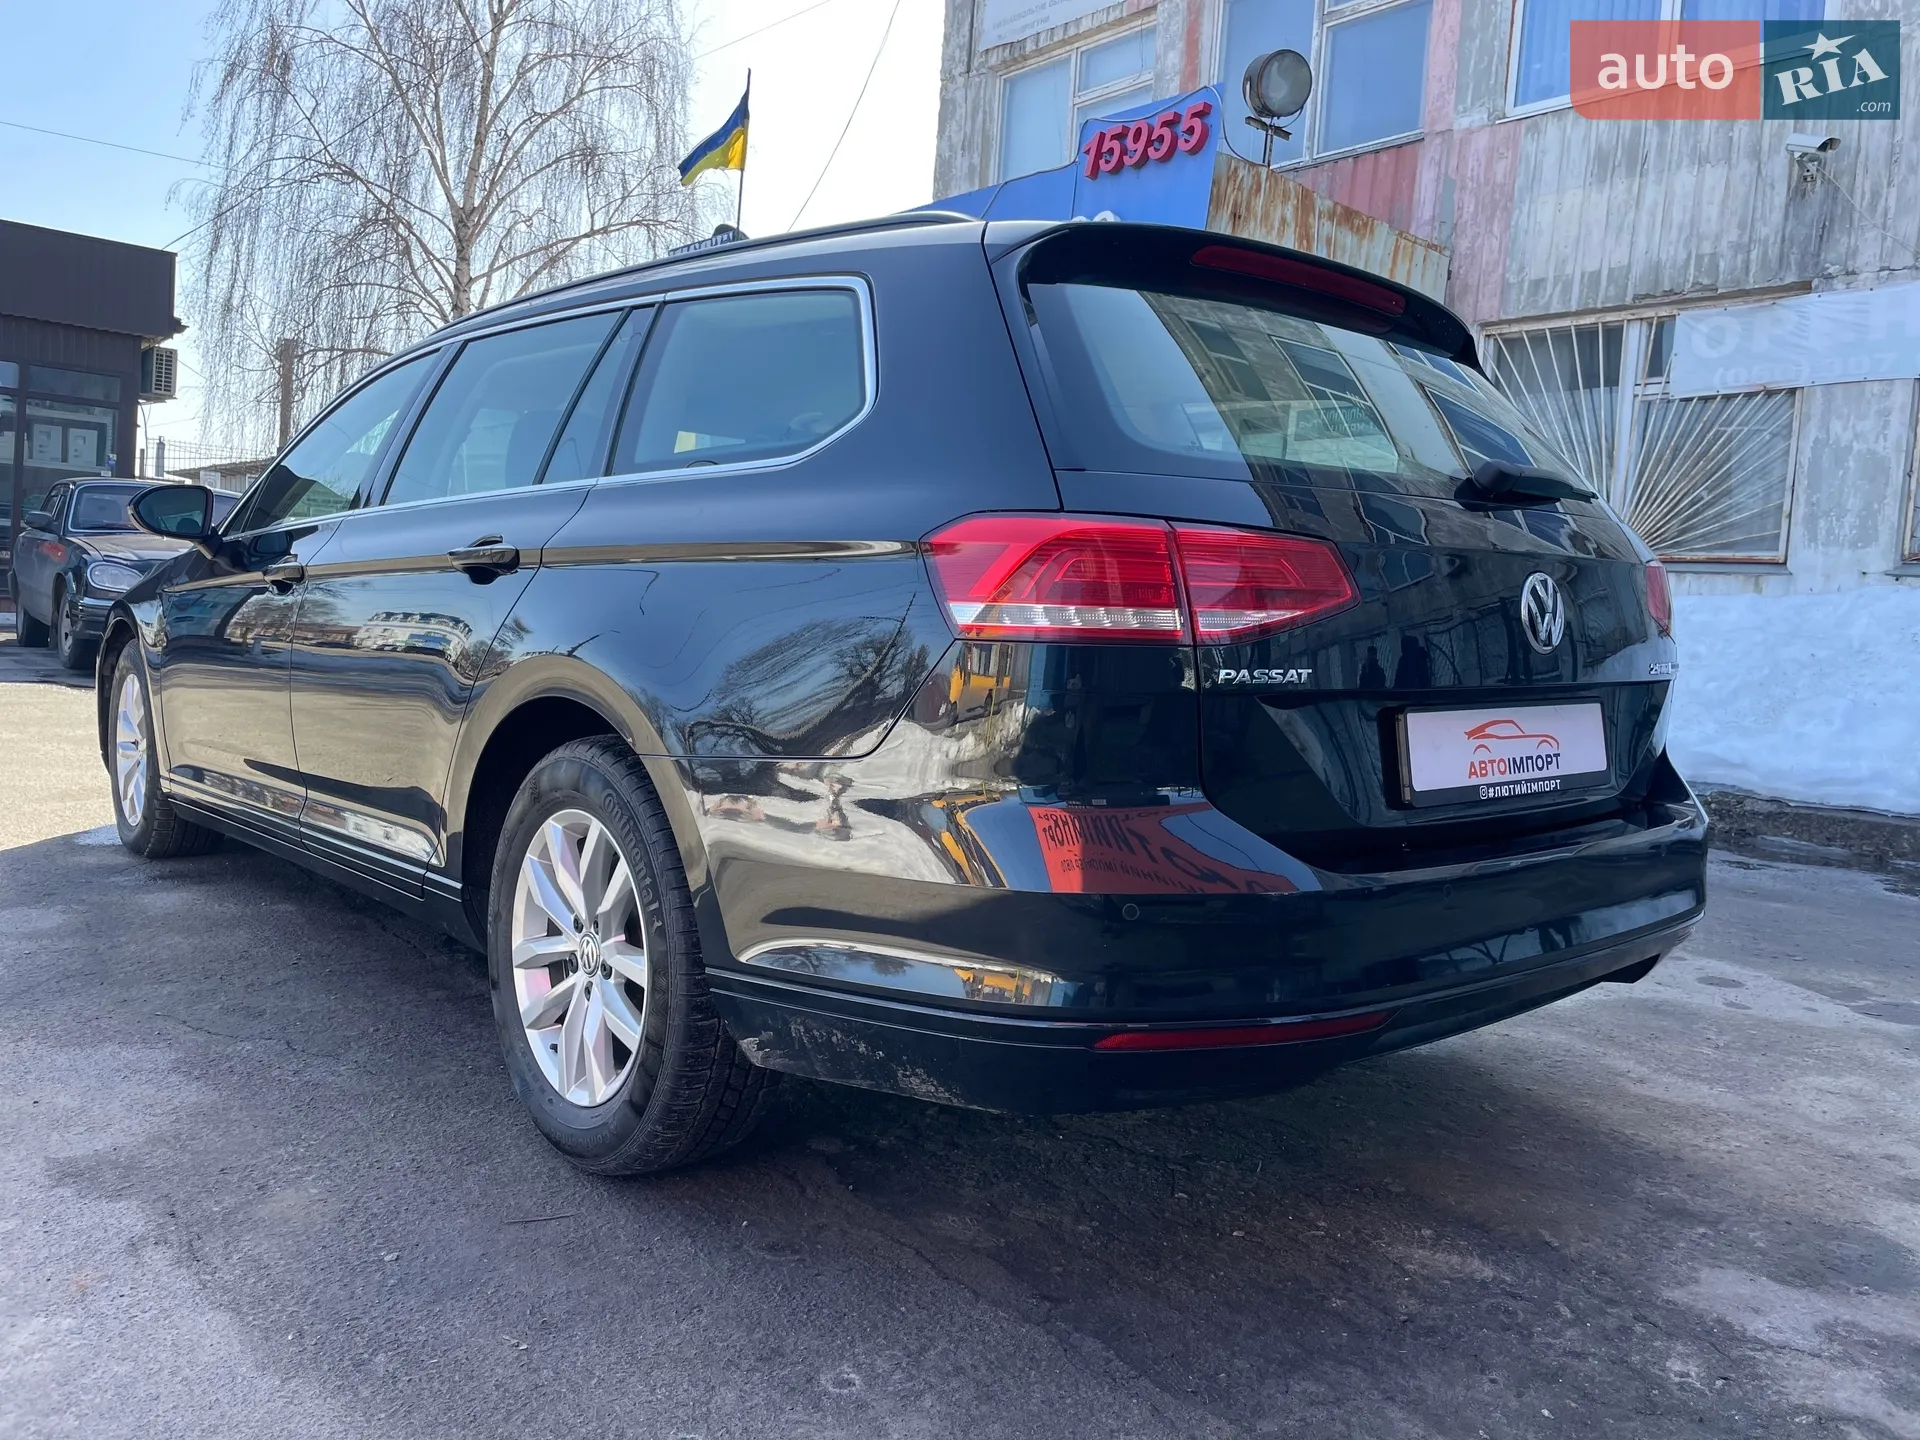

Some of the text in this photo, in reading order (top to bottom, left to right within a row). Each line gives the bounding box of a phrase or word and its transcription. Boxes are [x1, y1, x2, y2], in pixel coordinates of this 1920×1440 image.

[1083, 101, 1213, 181] 15955
[1218, 668, 1313, 685] PASSAT
[1467, 752, 1561, 779] АВТОІМПОРТ
[601, 788, 660, 913] Continental
